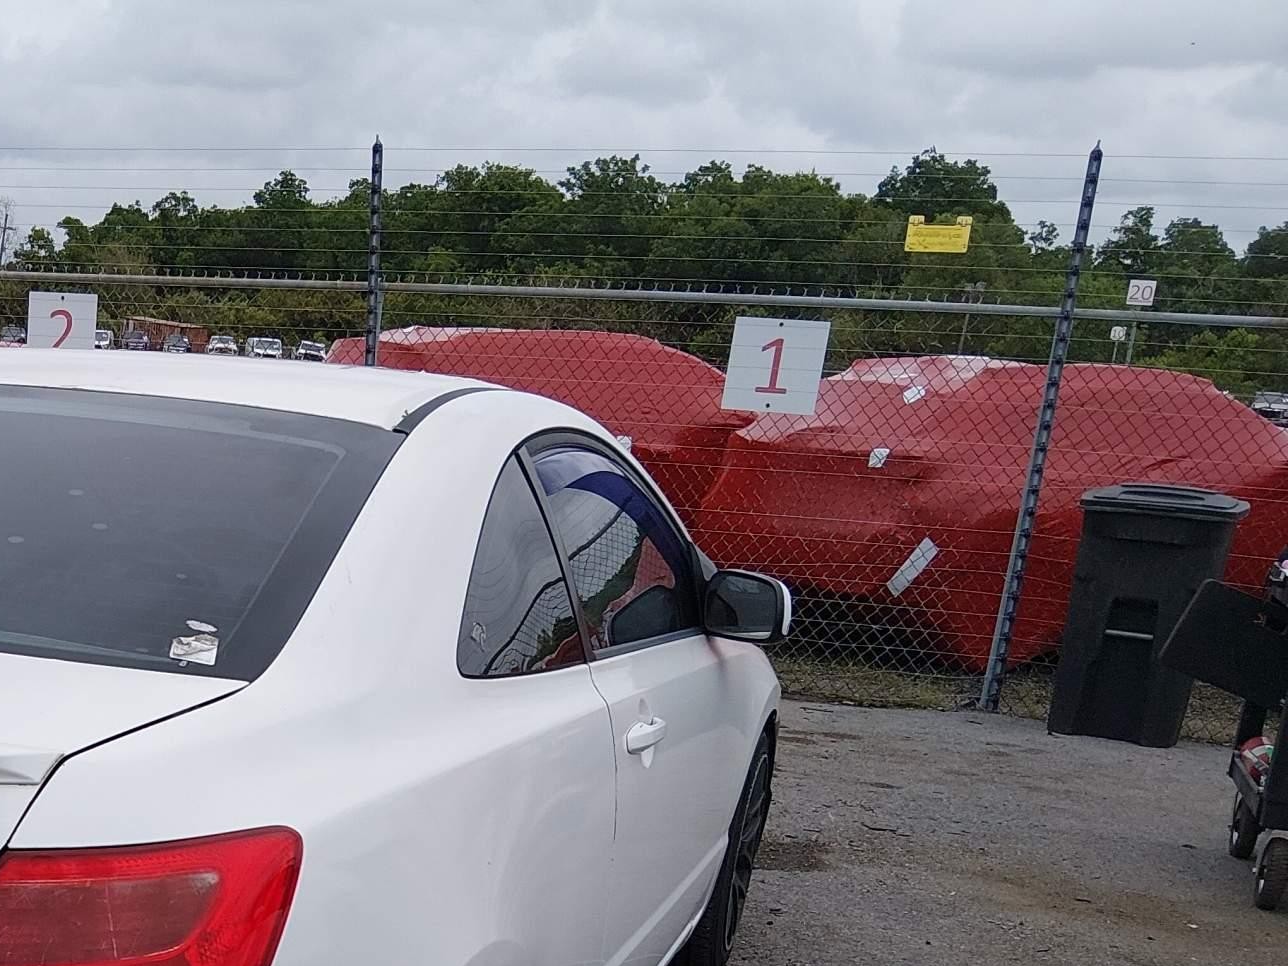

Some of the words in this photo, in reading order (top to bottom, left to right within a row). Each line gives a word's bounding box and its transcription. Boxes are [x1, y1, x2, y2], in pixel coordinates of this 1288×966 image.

[1128, 284, 1154, 301] 20
[50, 309, 73, 348] 2
[755, 338, 787, 394] 1
